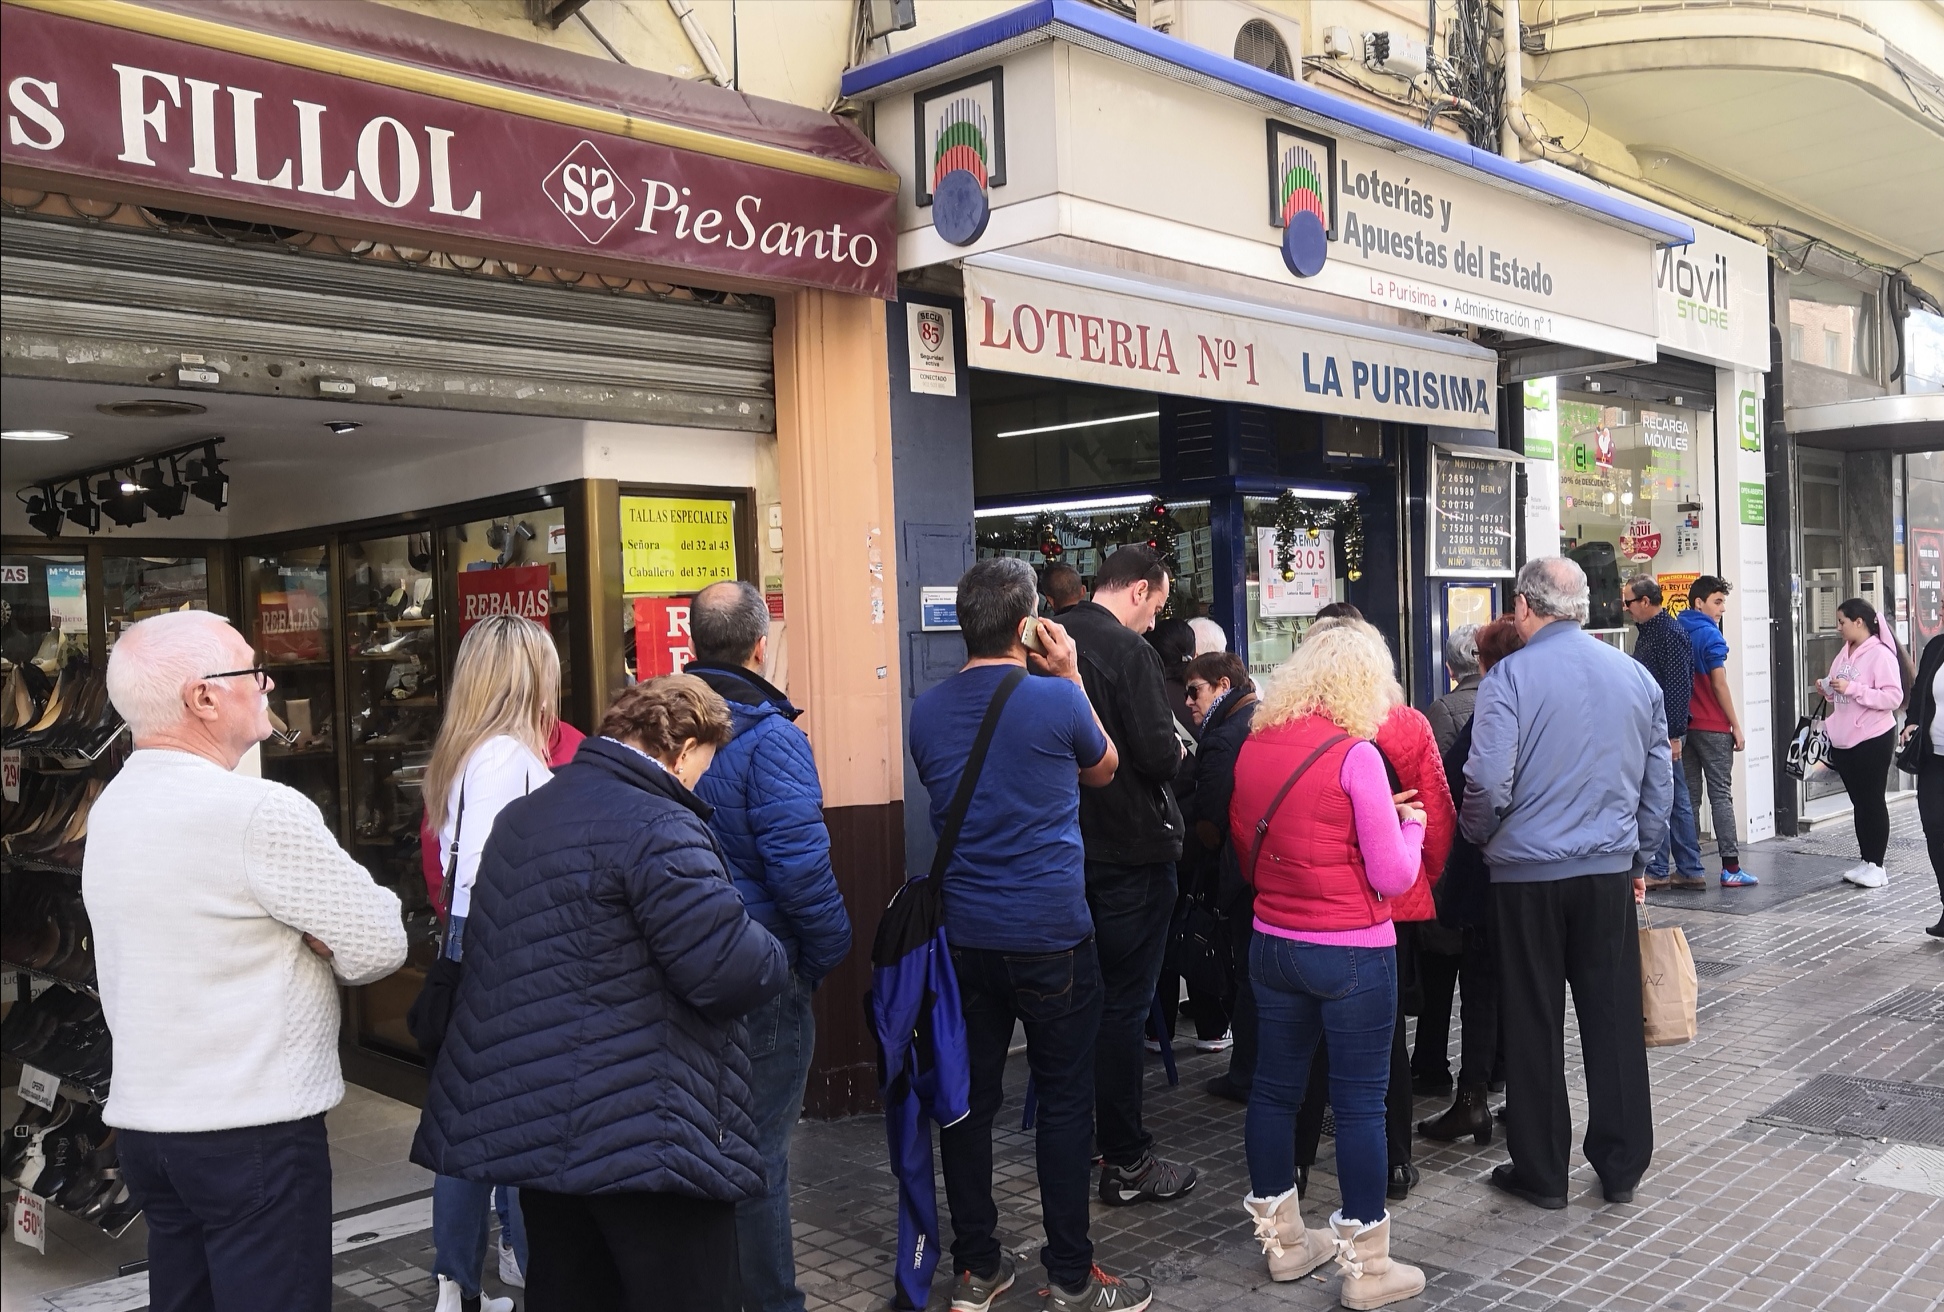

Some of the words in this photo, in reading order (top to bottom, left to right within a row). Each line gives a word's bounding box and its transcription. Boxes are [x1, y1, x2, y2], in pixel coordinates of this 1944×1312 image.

[112, 63, 482, 220] FILLOL
[1341, 159, 1434, 219] Loterías
[1439, 198, 1452, 233] y
[1343, 211, 1448, 269] Apuestas
[1453, 240, 1484, 279] del
[1489, 250, 1553, 296] Estado
[1370, 276, 1384, 296] La
[1454, 297, 1530, 329] Administración
[920, 312, 940, 322] SECU
[1677, 299, 1728, 330] STORE
[922, 322, 939, 344] 85
[979, 296, 1180, 375] LOTERIA
[920, 353, 944, 362] Seguridad
[920, 374, 947, 382] CONECTADO
[1302, 352, 1343, 397] LA
[1352, 360, 1490, 415] PURISIMA
[1642, 415, 1689, 435] RECARGA
[1644, 431, 1688, 451] MÓVILES
[1454, 459, 1485, 470] NAVIDAD
[1448, 473, 1474, 484] 26590
[1581, 478, 1610, 488] DESCUENTO
[1449, 486, 1474, 496] 10989
[1497, 486, 1502, 495] 0
[1448, 500, 1474, 510] 00750
[629, 508, 668, 523] TALLAS
[670, 510, 728, 524] ESPECIALES
[1449, 523, 1474, 533] 75206
[1629, 521, 1651, 537] AQUÍ
[627, 539, 660, 550] Señora
[681, 540, 694, 550] del
[696, 541, 706, 550] 32
[709, 541, 717, 550] al
[719, 541, 729, 551] 43
[1449, 535, 1474, 544] 23059
[1480, 536, 1504, 546] 54527
[1479, 546, 1499, 556] EXTRA
[1268, 549, 1325, 570] 1305
[1448, 555, 1466, 566] NIÑO
[629, 566, 675, 578] Caballero
[680, 567, 694, 577] del
[696, 567, 707, 577] 37
[710, 567, 718, 577] al
[721, 567, 730, 577] 51
[1669, 583, 1681, 591] REY
[464, 589, 549, 620] REBAJAS
[262, 607, 319, 635] REBAJAS
[19, 1195, 43, 1212] HASTA
